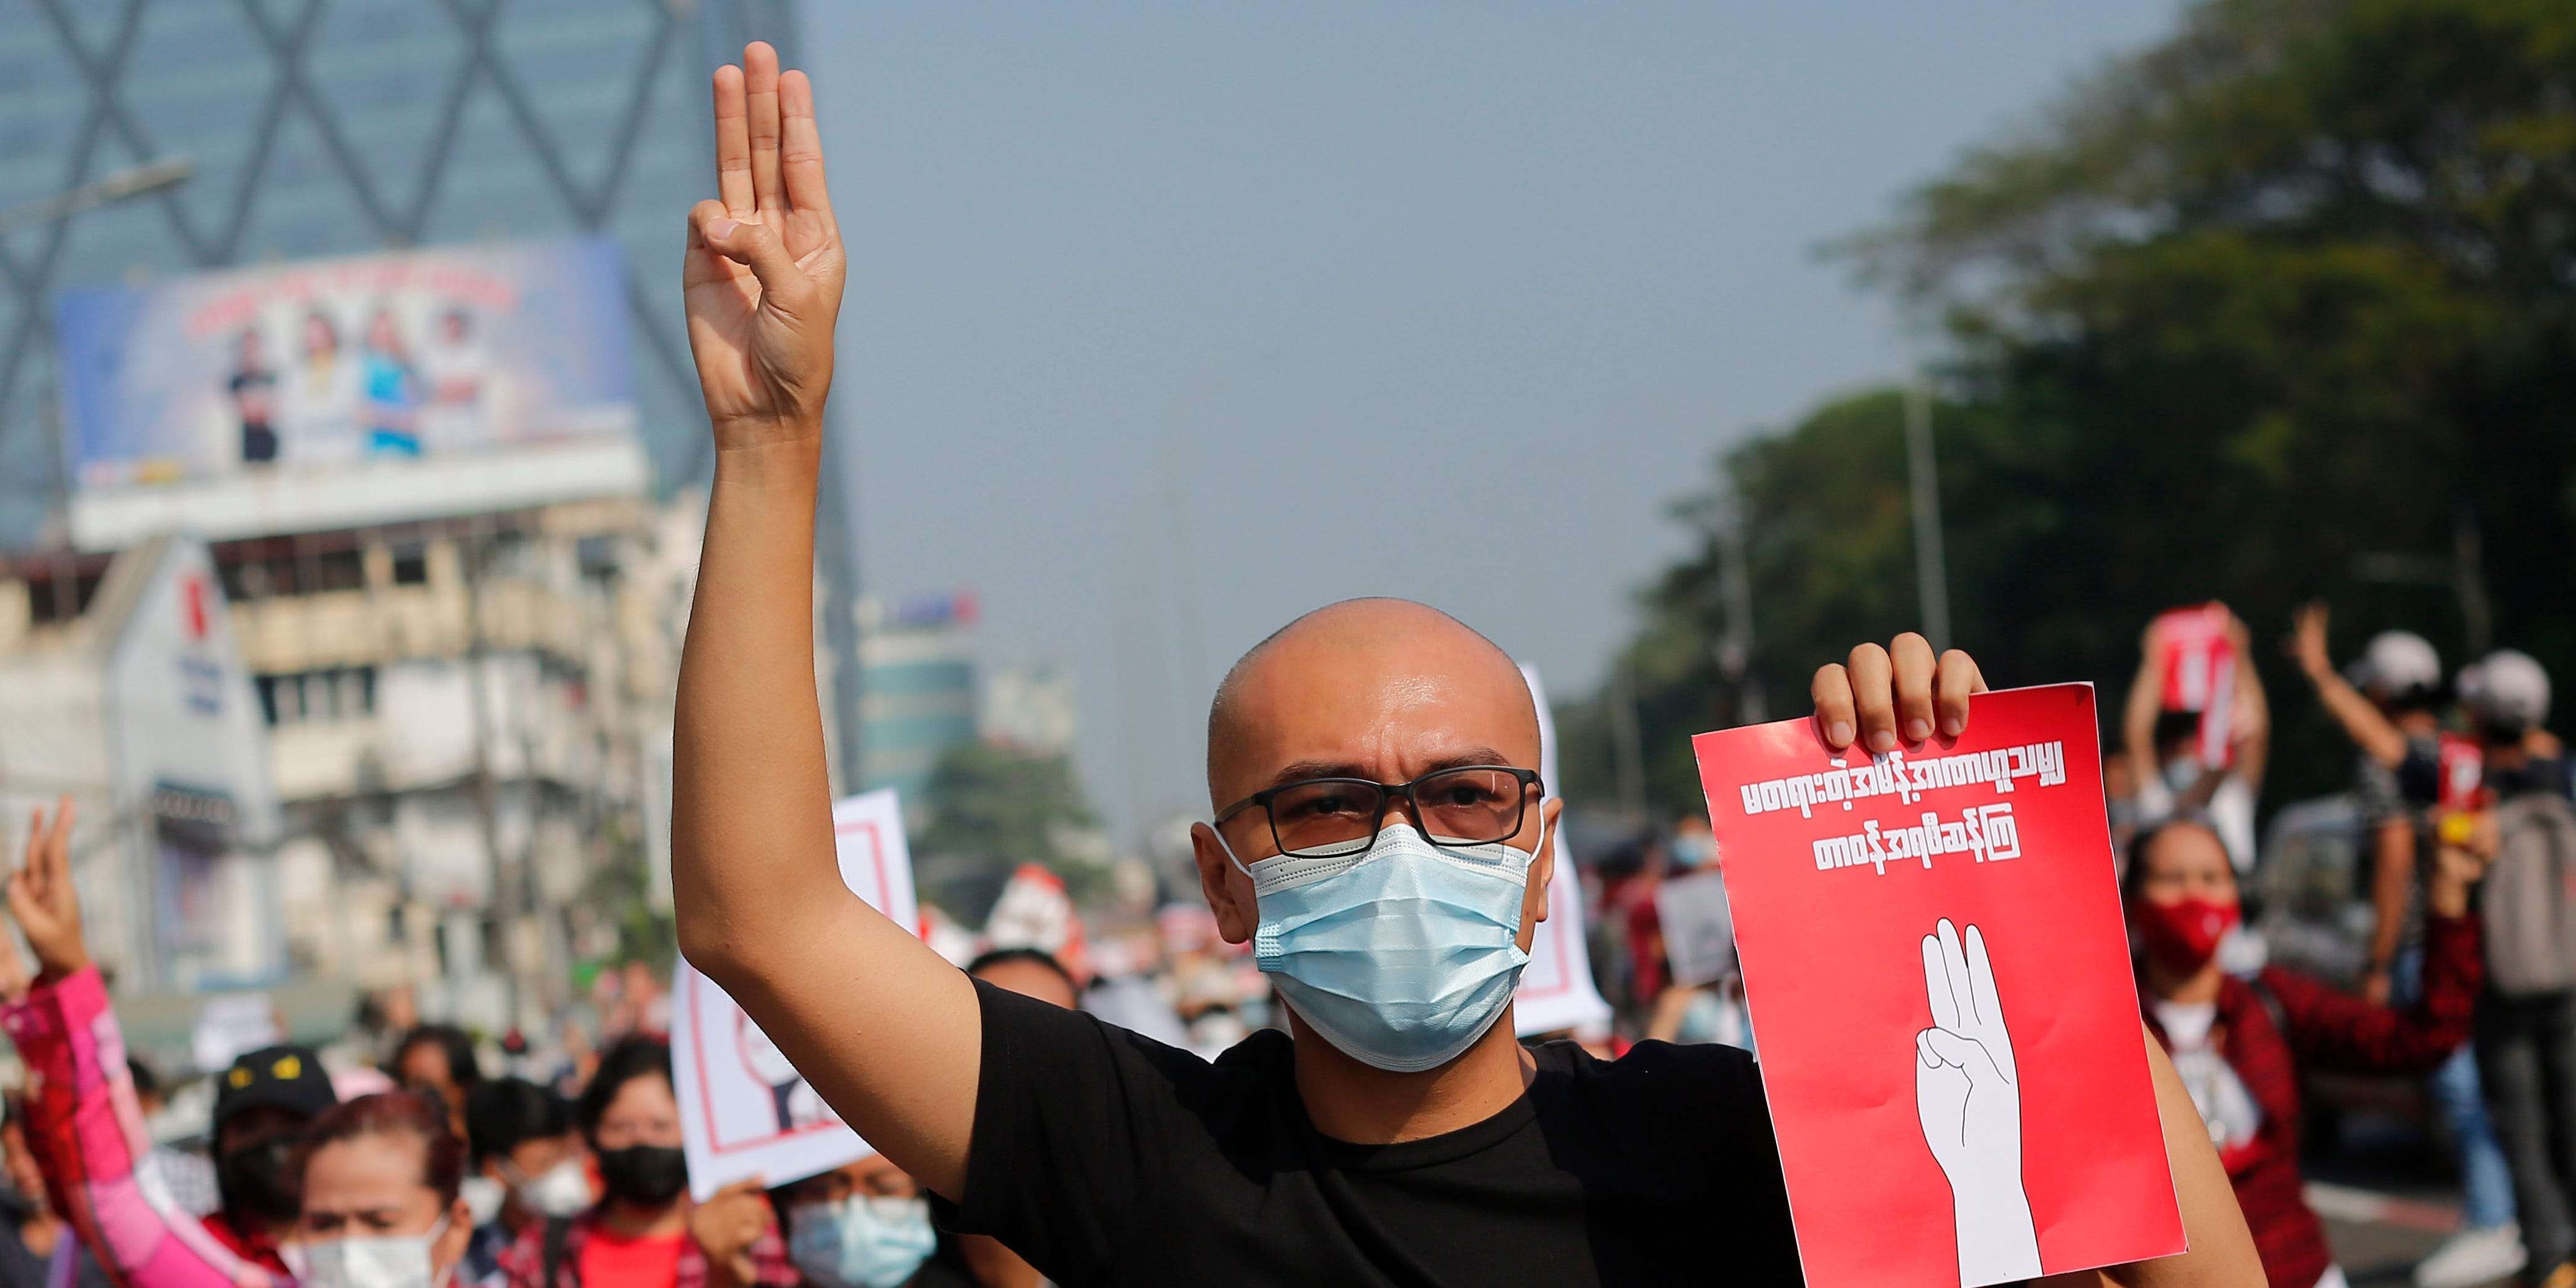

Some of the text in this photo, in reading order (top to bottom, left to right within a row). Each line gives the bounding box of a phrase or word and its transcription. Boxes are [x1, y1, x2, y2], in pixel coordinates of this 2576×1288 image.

[1812, 802, 2021, 875] တာဝန်အရဖီဆန်ကြ
